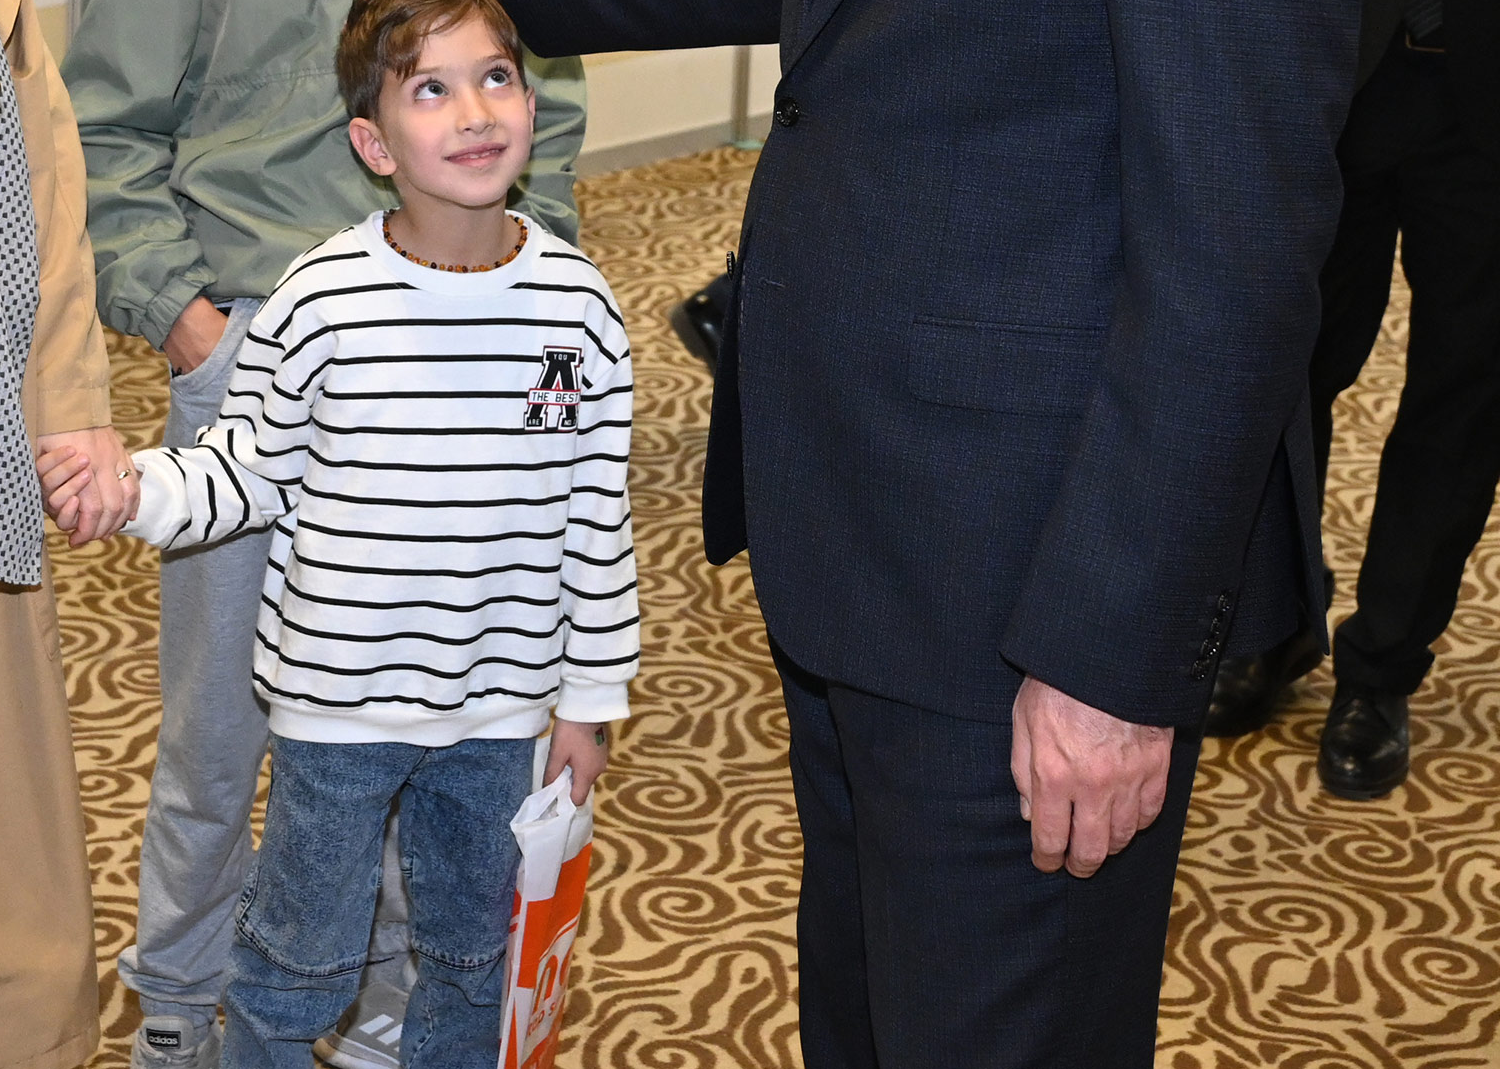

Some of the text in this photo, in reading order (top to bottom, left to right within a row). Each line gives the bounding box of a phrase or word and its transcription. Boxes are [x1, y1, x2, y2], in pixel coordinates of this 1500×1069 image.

[553, 353, 568, 361] YOU
[532, 391, 579, 403] THE BEST
